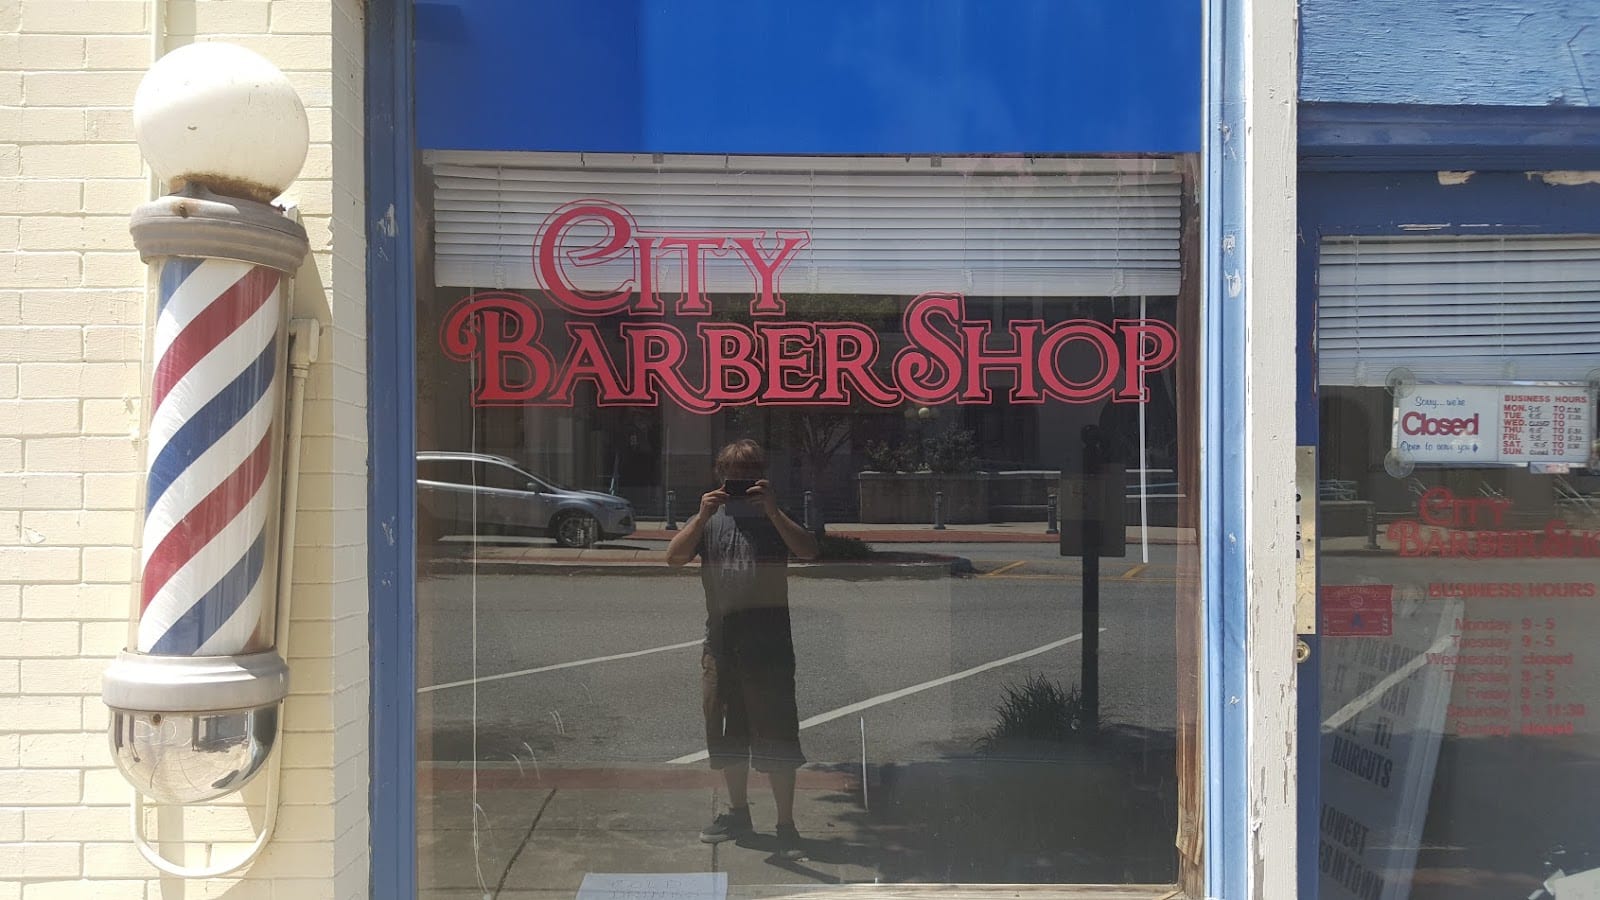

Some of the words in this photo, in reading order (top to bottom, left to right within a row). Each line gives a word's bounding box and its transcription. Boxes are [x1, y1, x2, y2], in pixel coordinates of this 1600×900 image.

[533, 198, 810, 315] CITY
[440, 291, 902, 413] BARBER
[894, 291, 1181, 406] SHOP
[1503, 394, 1551, 403] BUSINESS
[1555, 395, 1588, 404] HOURS
[1503, 404, 1527, 412] MON.
[1402, 411, 1480, 436] Closed
[1400, 440, 1421, 452] Open
[1425, 442, 1433, 451] to
[1503, 440, 1524, 448] SAT.
[1387, 519, 1541, 561] BARBER
[1428, 581, 1524, 598] BUSINESS
[1529, 581, 1596, 597] HOURS
[1521, 617, 1533, 630] 9
[1545, 617, 1556, 630] 5
[1521, 634, 1533, 648] 9
[1545, 634, 1556, 648] 5
[1521, 651, 1575, 665] closed
[1521, 669, 1533, 682] 9
[1545, 669, 1556, 682] 5
[1521, 687, 1533, 700] 9
[1545, 687, 1556, 700] 5
[1331, 735, 1393, 789] HAIRCUTS
